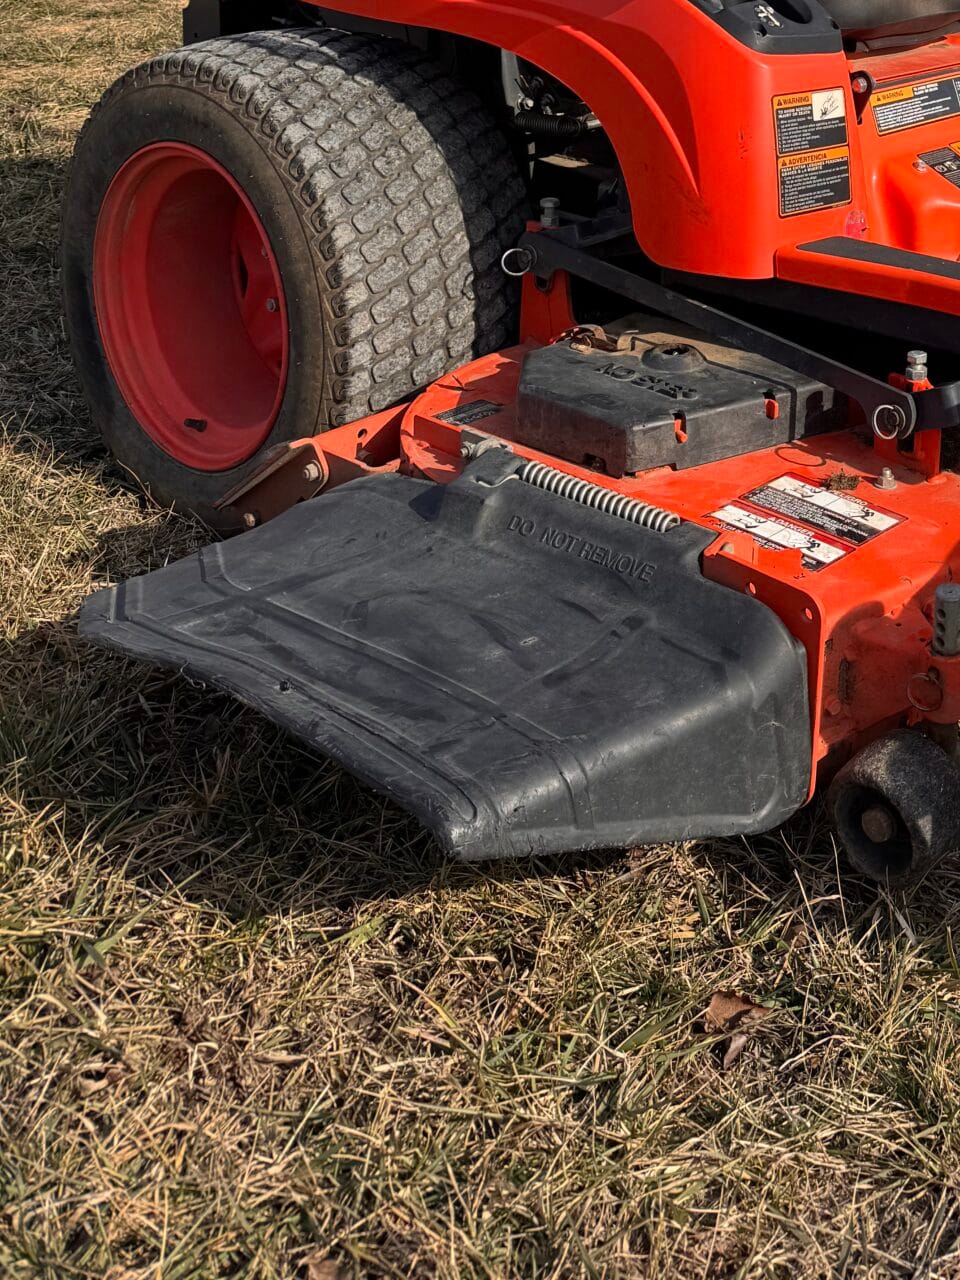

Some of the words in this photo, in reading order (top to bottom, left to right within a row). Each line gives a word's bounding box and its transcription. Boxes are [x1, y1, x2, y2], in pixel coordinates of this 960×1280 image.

[783, 96, 810, 105] WARNING
[788, 153, 828, 166] ADVERTENCIA
[776, 519, 815, 536] DANGER
[507, 515, 536, 537] DO
[539, 527, 582, 553] NOT
[578, 540, 657, 583] REMOVE
